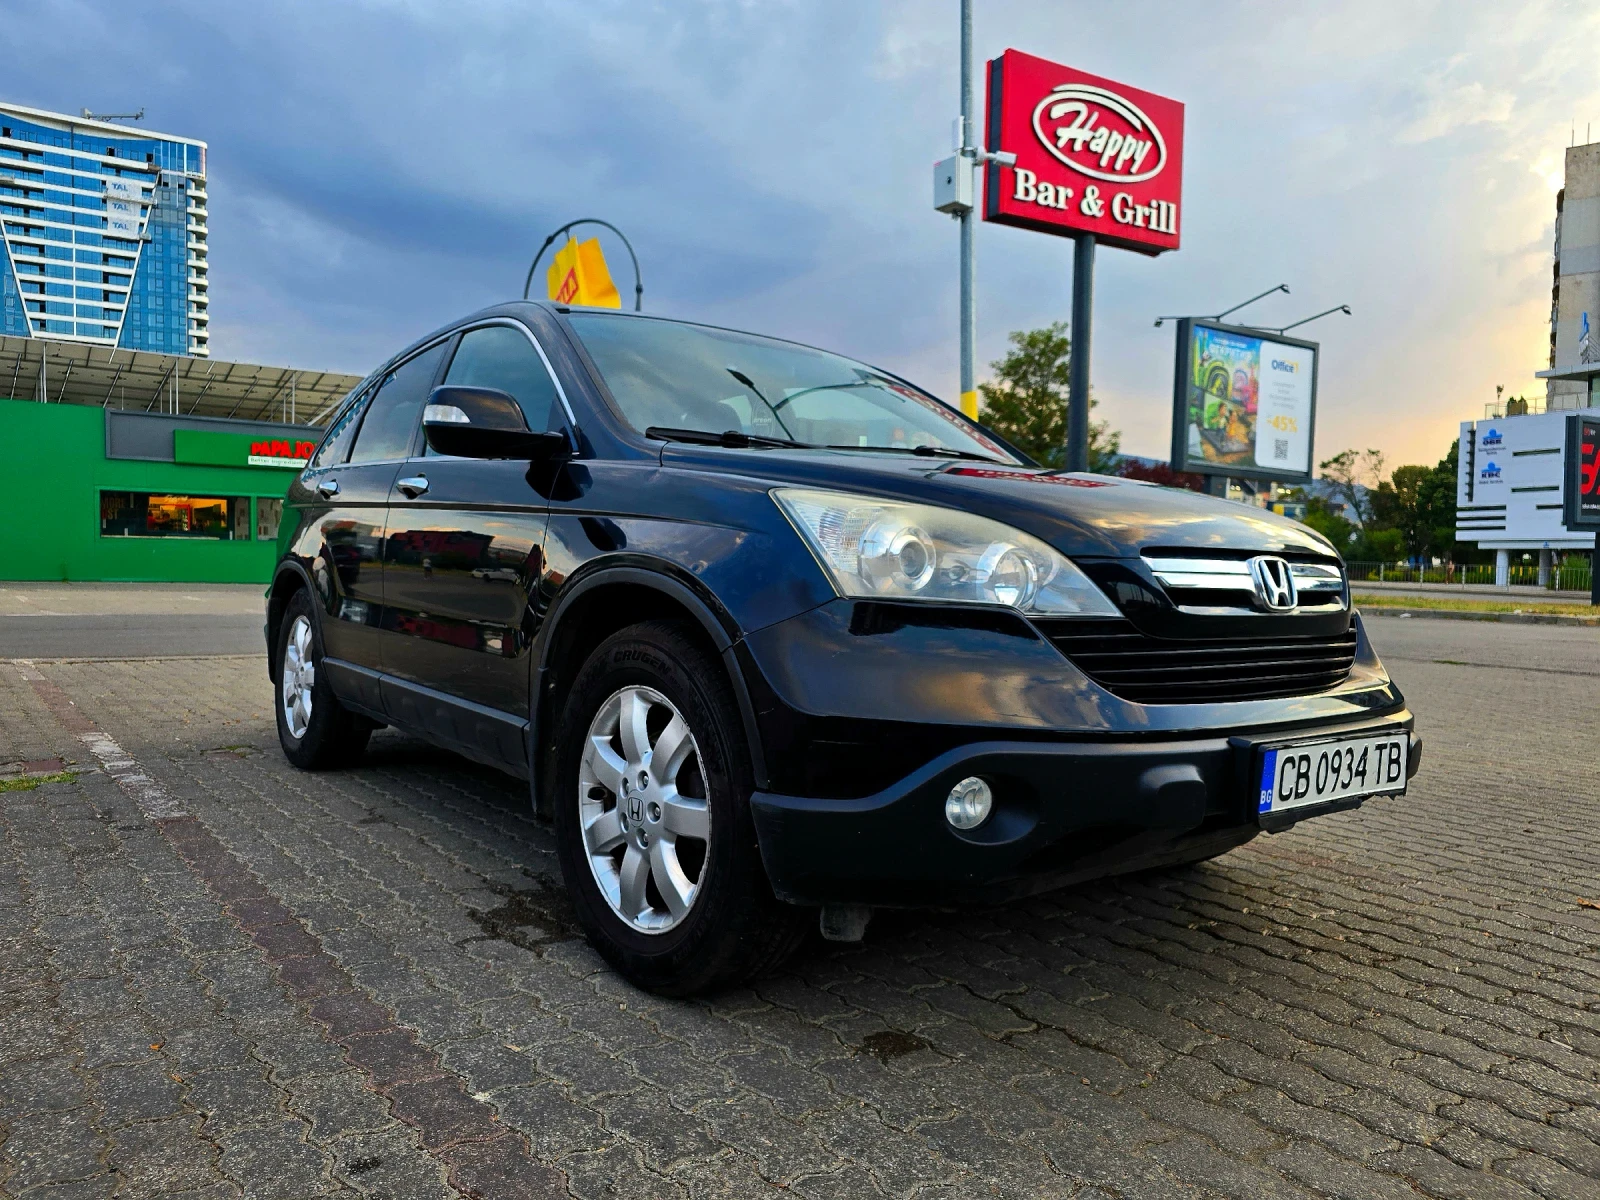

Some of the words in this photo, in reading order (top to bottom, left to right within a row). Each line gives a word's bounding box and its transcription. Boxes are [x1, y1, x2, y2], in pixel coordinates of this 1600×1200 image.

[1050, 101, 1152, 174] Happy
[1013, 167, 1074, 210] Bar
[1080, 185, 1104, 218] &
[1112, 192, 1177, 235] Grill
[1271, 360, 1294, 373] Office
[251, 440, 294, 458] PAPA
[293, 440, 317, 459] JO
[613, 649, 672, 676] CRUGEN
[1278, 753, 1311, 802] CB
[1315, 743, 1369, 795] 0934
[1374, 741, 1402, 785] TB
[1259, 790, 1272, 805] BG
